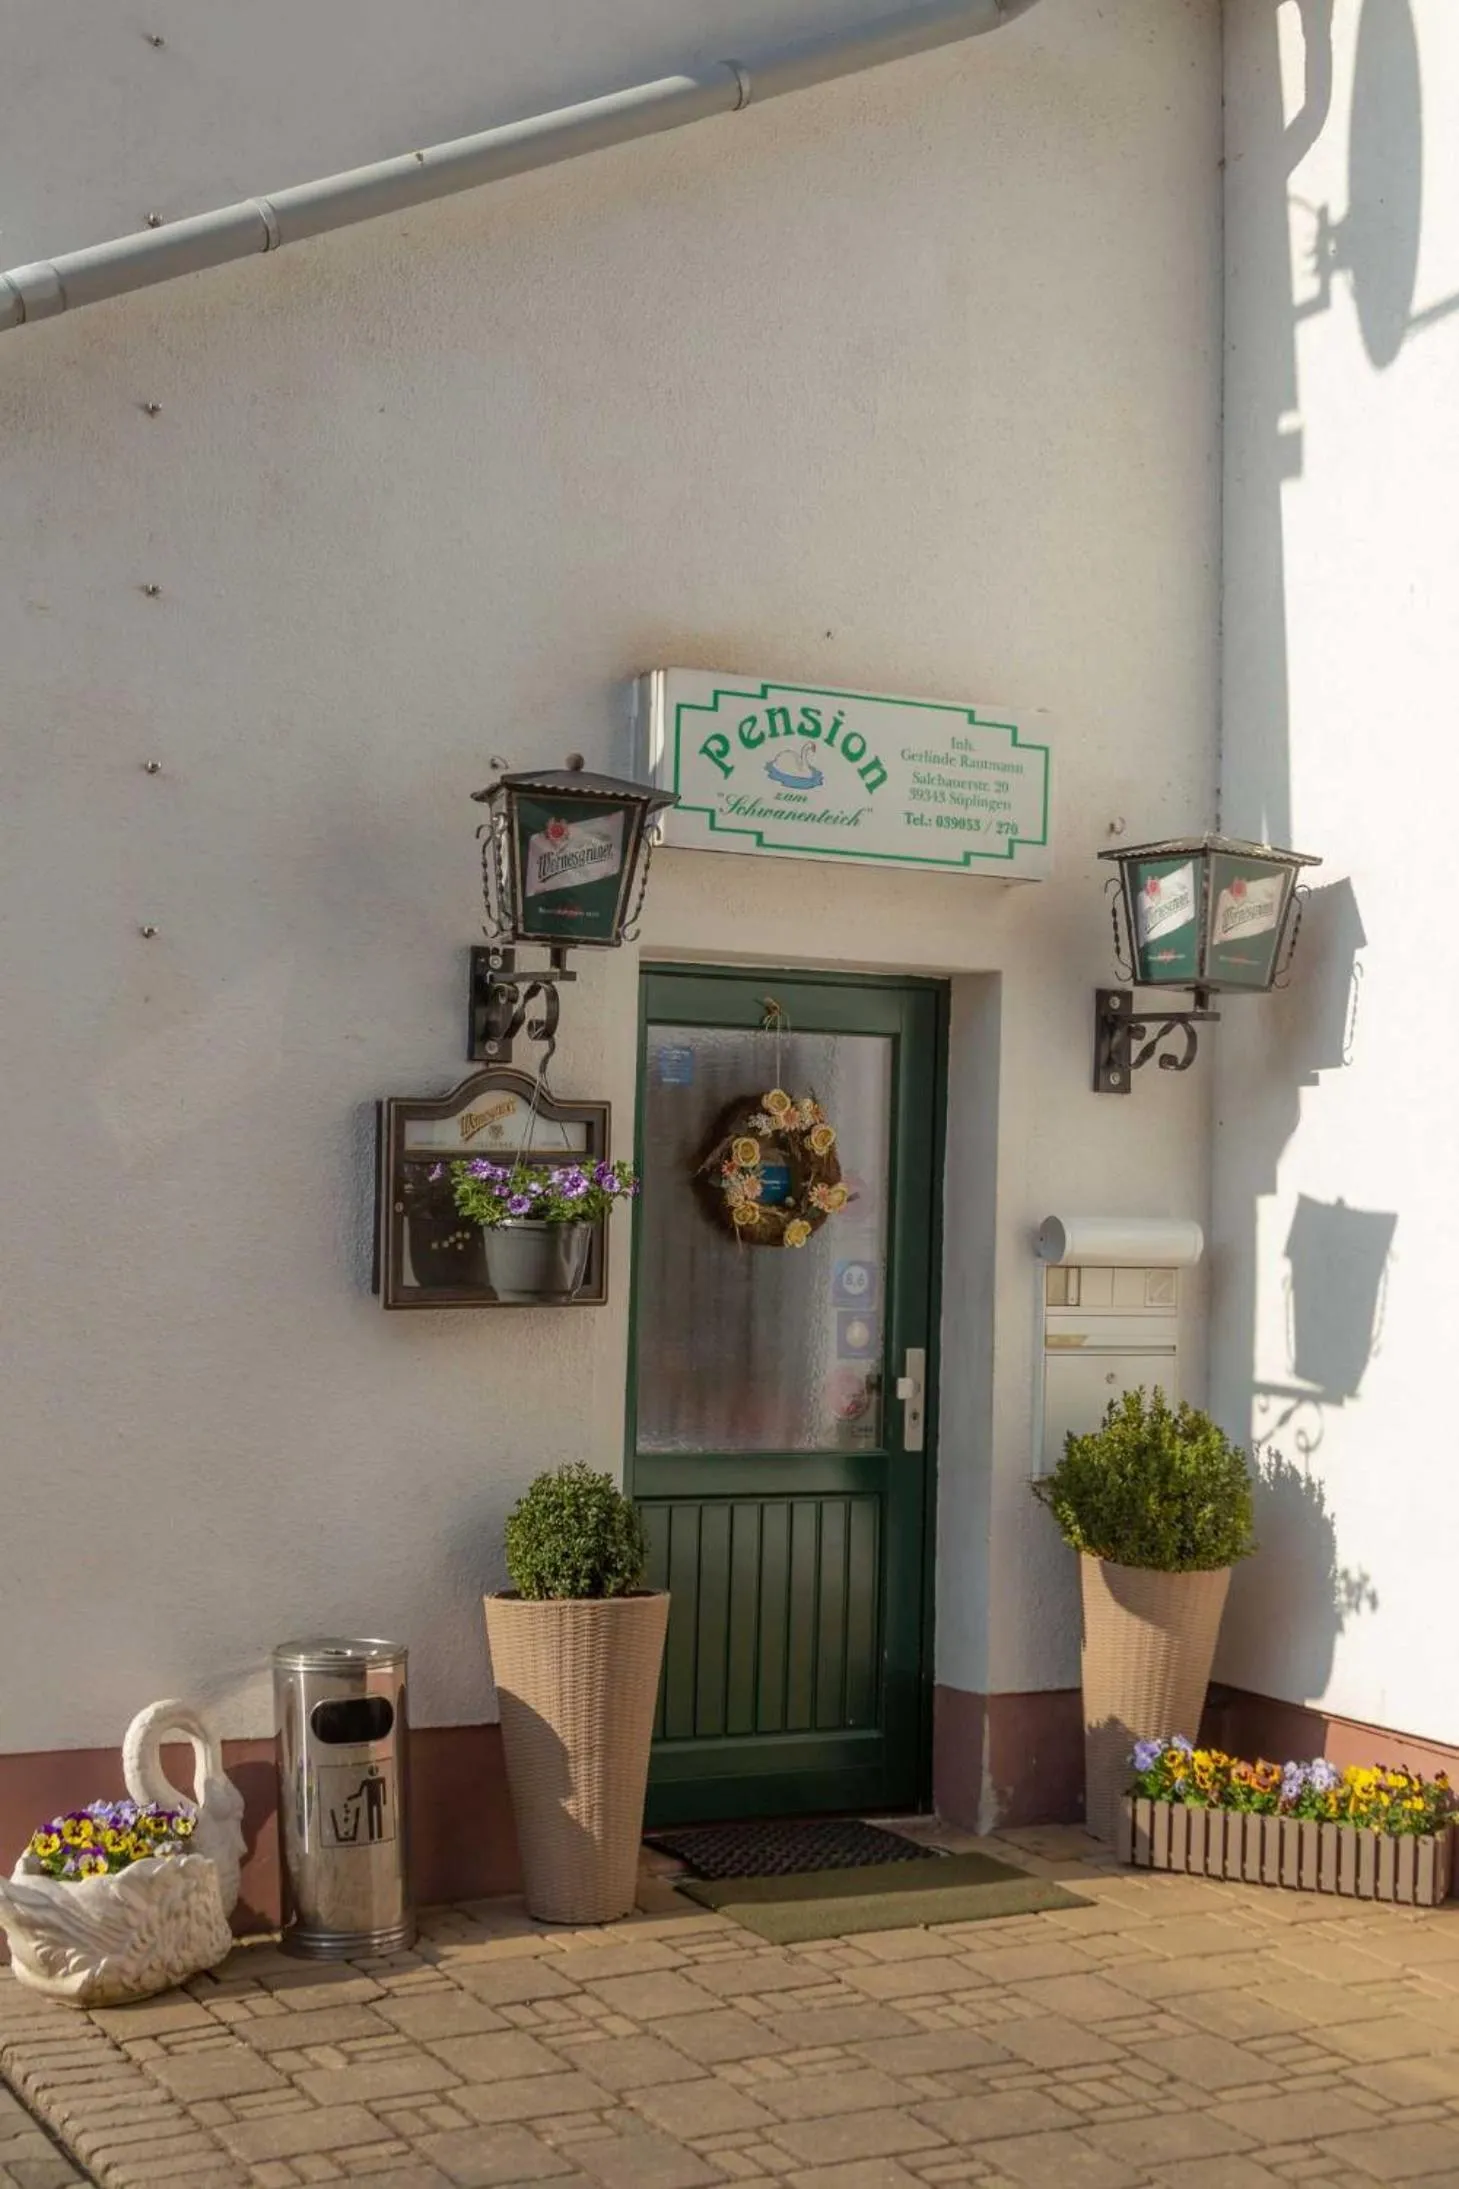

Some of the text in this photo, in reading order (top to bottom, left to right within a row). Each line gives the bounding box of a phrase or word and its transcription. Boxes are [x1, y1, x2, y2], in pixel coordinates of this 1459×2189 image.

[699, 706, 888, 795] Pension
[951, 736, 977, 752] Inh.
[900, 748, 957, 768] Gerlinde
[774, 792, 808, 803] zum
[904, 812, 932, 827] Tel.:
